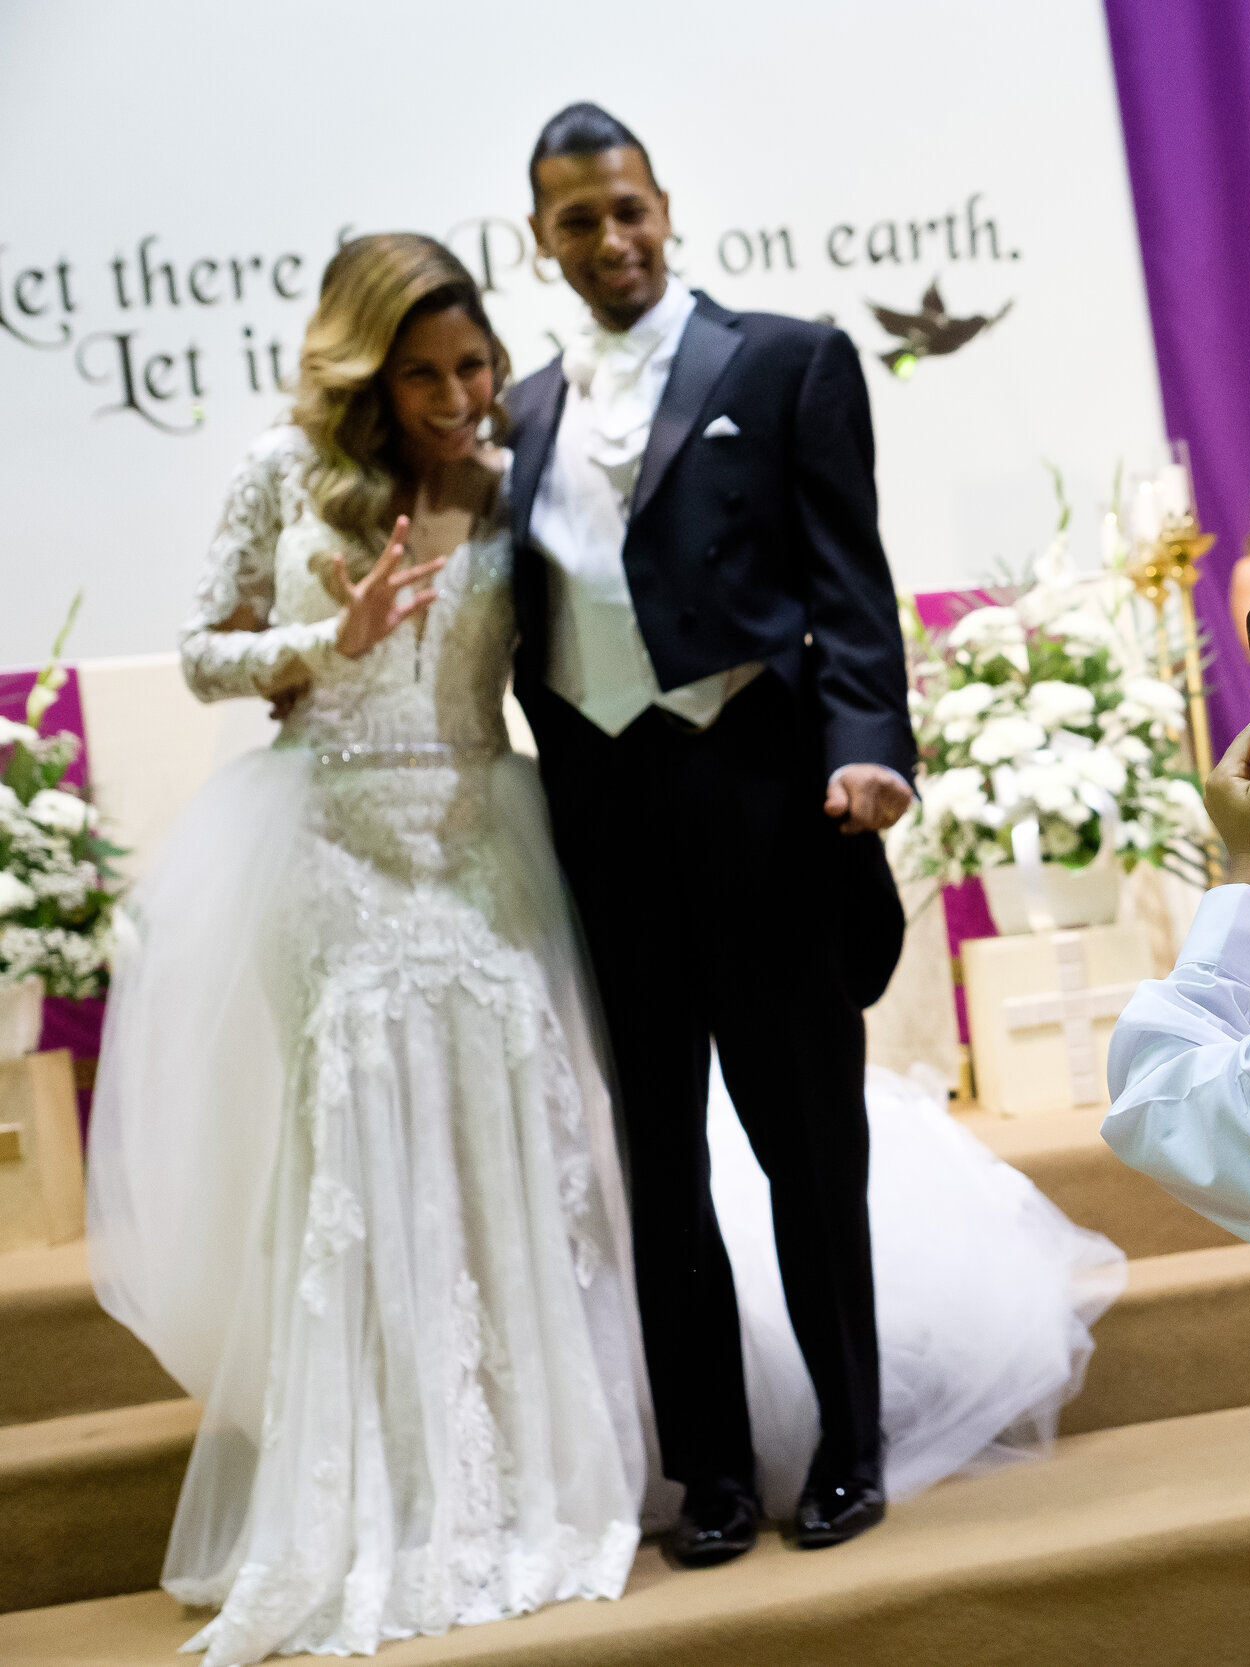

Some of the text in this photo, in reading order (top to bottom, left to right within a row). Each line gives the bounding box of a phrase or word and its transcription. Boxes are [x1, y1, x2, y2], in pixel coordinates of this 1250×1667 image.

[109, 232, 304, 310] there
[716, 224, 798, 276] on
[825, 189, 1021, 270] earth.
[73, 324, 287, 438] Let it
